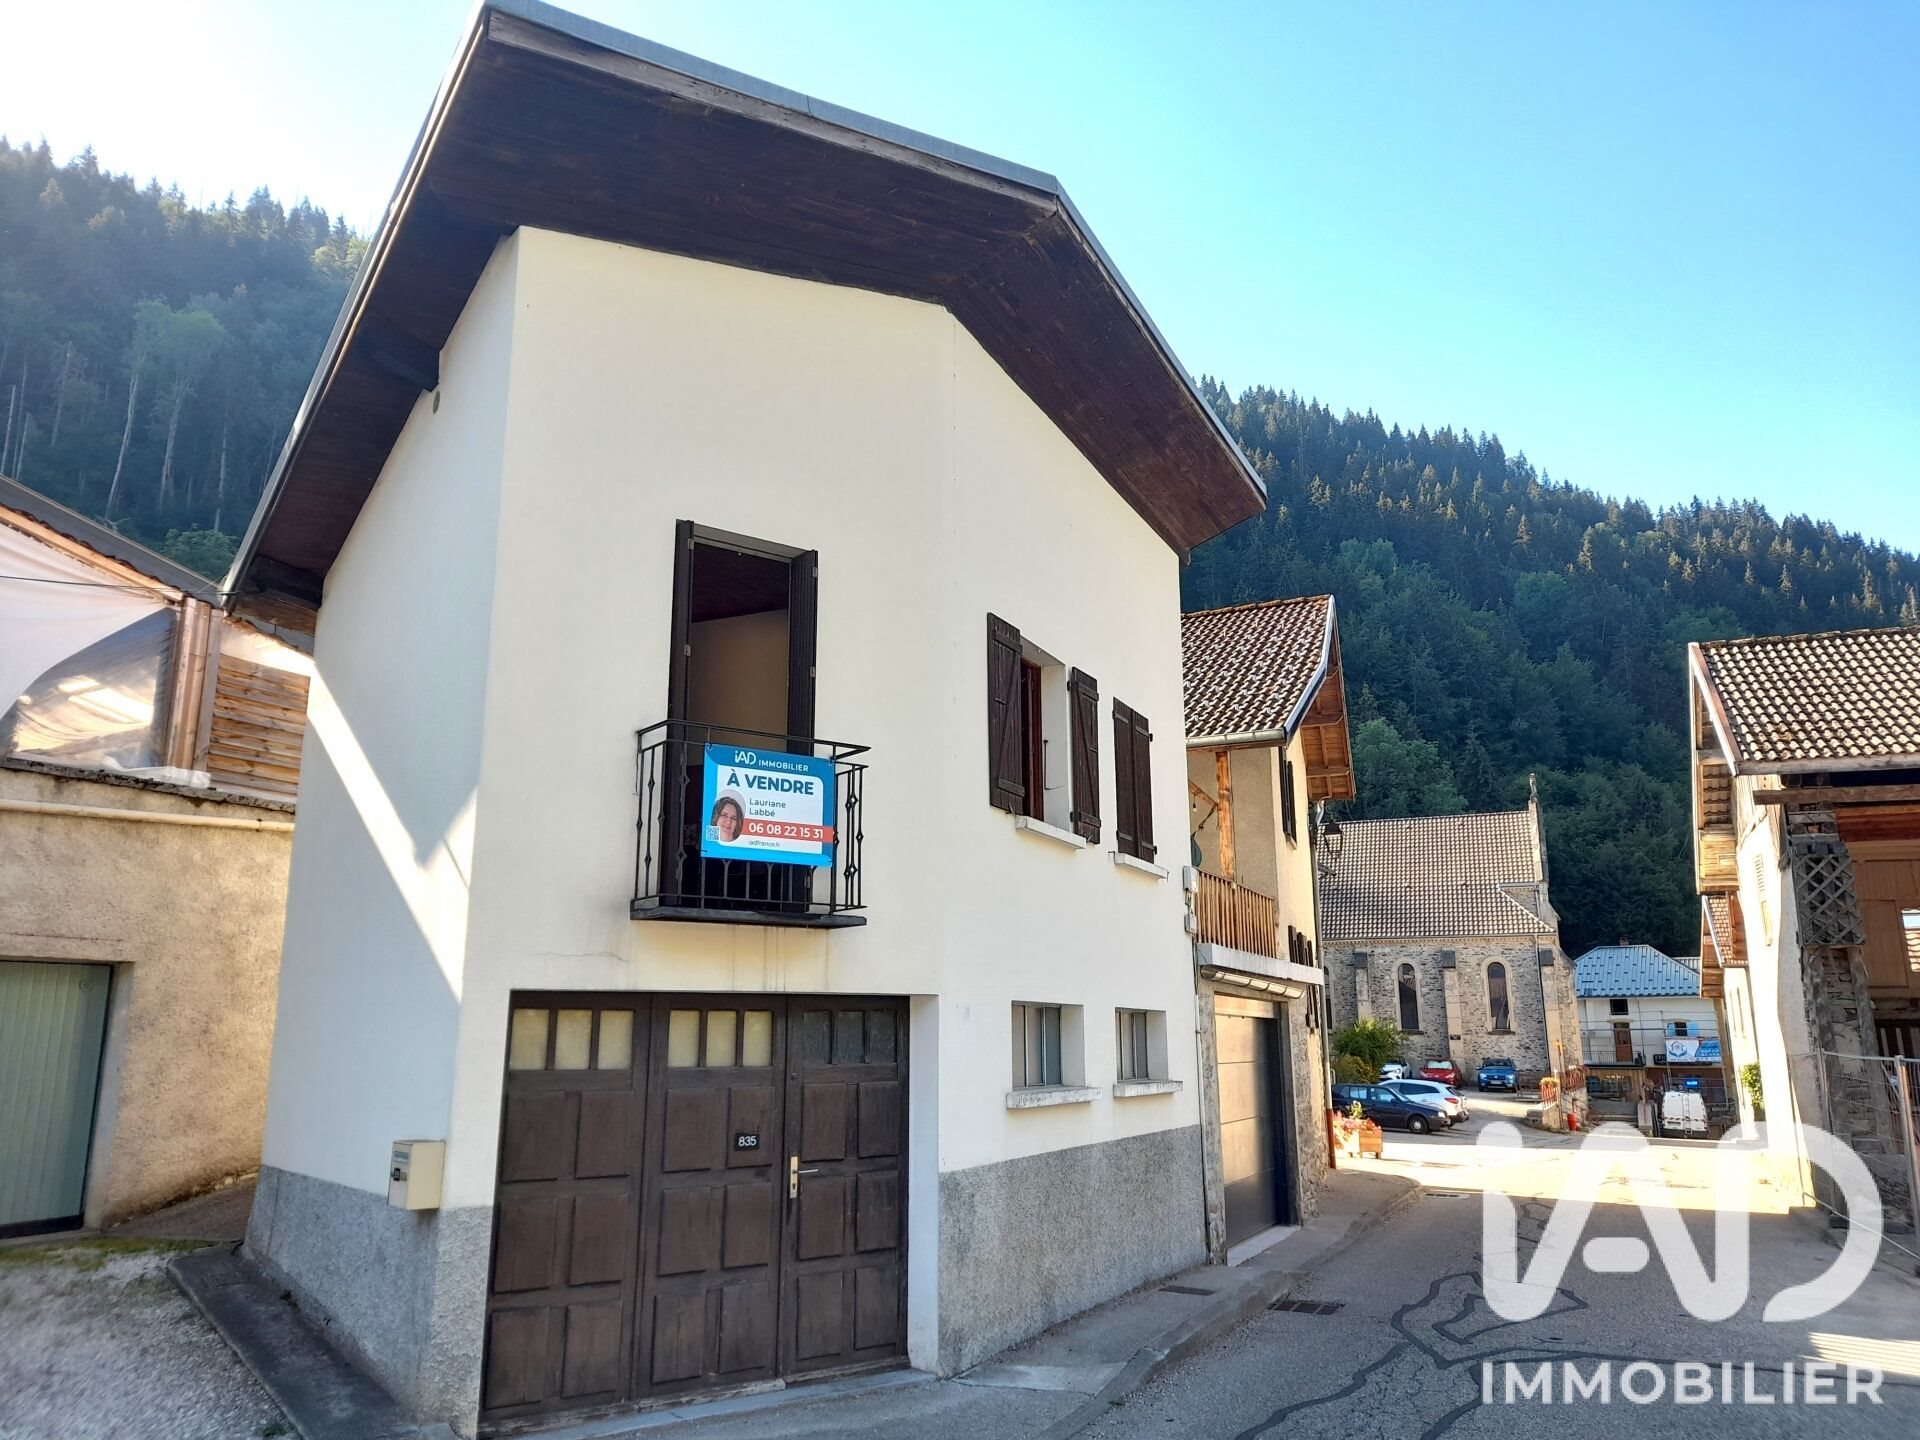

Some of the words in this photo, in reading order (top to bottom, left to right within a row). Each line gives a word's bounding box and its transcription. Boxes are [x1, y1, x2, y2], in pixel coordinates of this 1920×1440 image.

[758, 759, 808, 772] IMMOBILIER
[727, 768, 740, 787] À
[745, 774, 814, 795] VENDRE
[749, 797, 786, 808] Lauriane
[748, 807, 776, 818] Labbé
[748, 822, 764, 833] 06
[766, 824, 782, 835] 08
[784, 826, 798, 837] 22
[799, 826, 811, 838] 15
[813, 828, 824, 839] 31
[738, 1136, 757, 1147] 835
